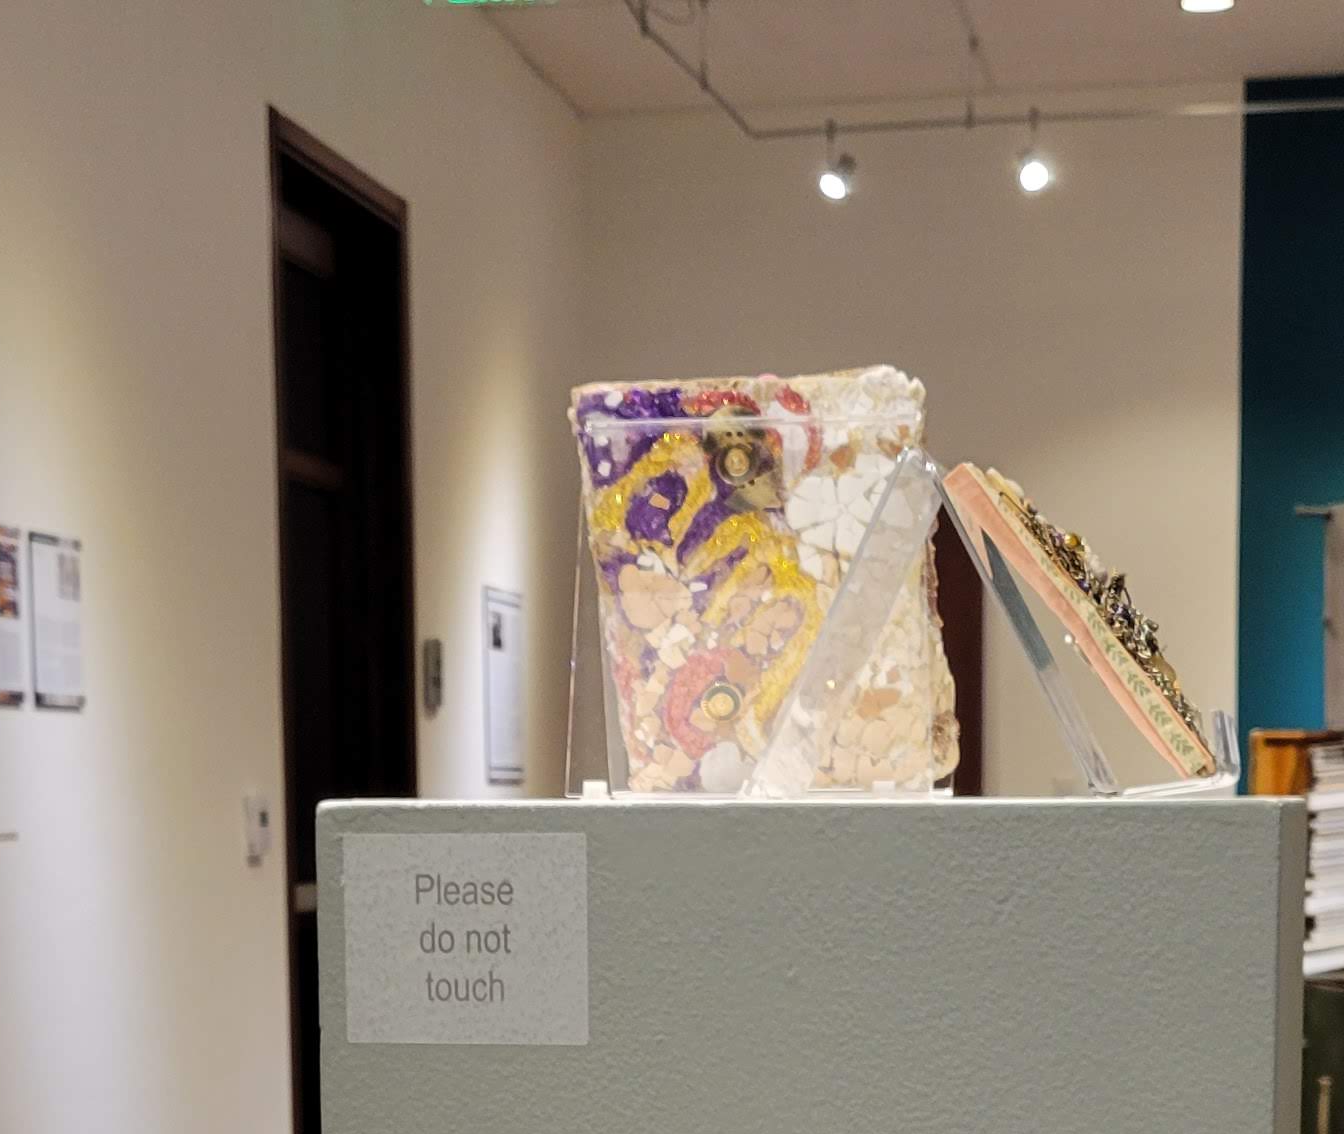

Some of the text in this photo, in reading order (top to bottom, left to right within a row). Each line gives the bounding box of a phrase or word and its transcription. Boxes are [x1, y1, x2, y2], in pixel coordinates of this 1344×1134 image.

[414, 872, 514, 907] Please
[419, 922, 512, 955] do not
[426, 971, 505, 1004] touch
